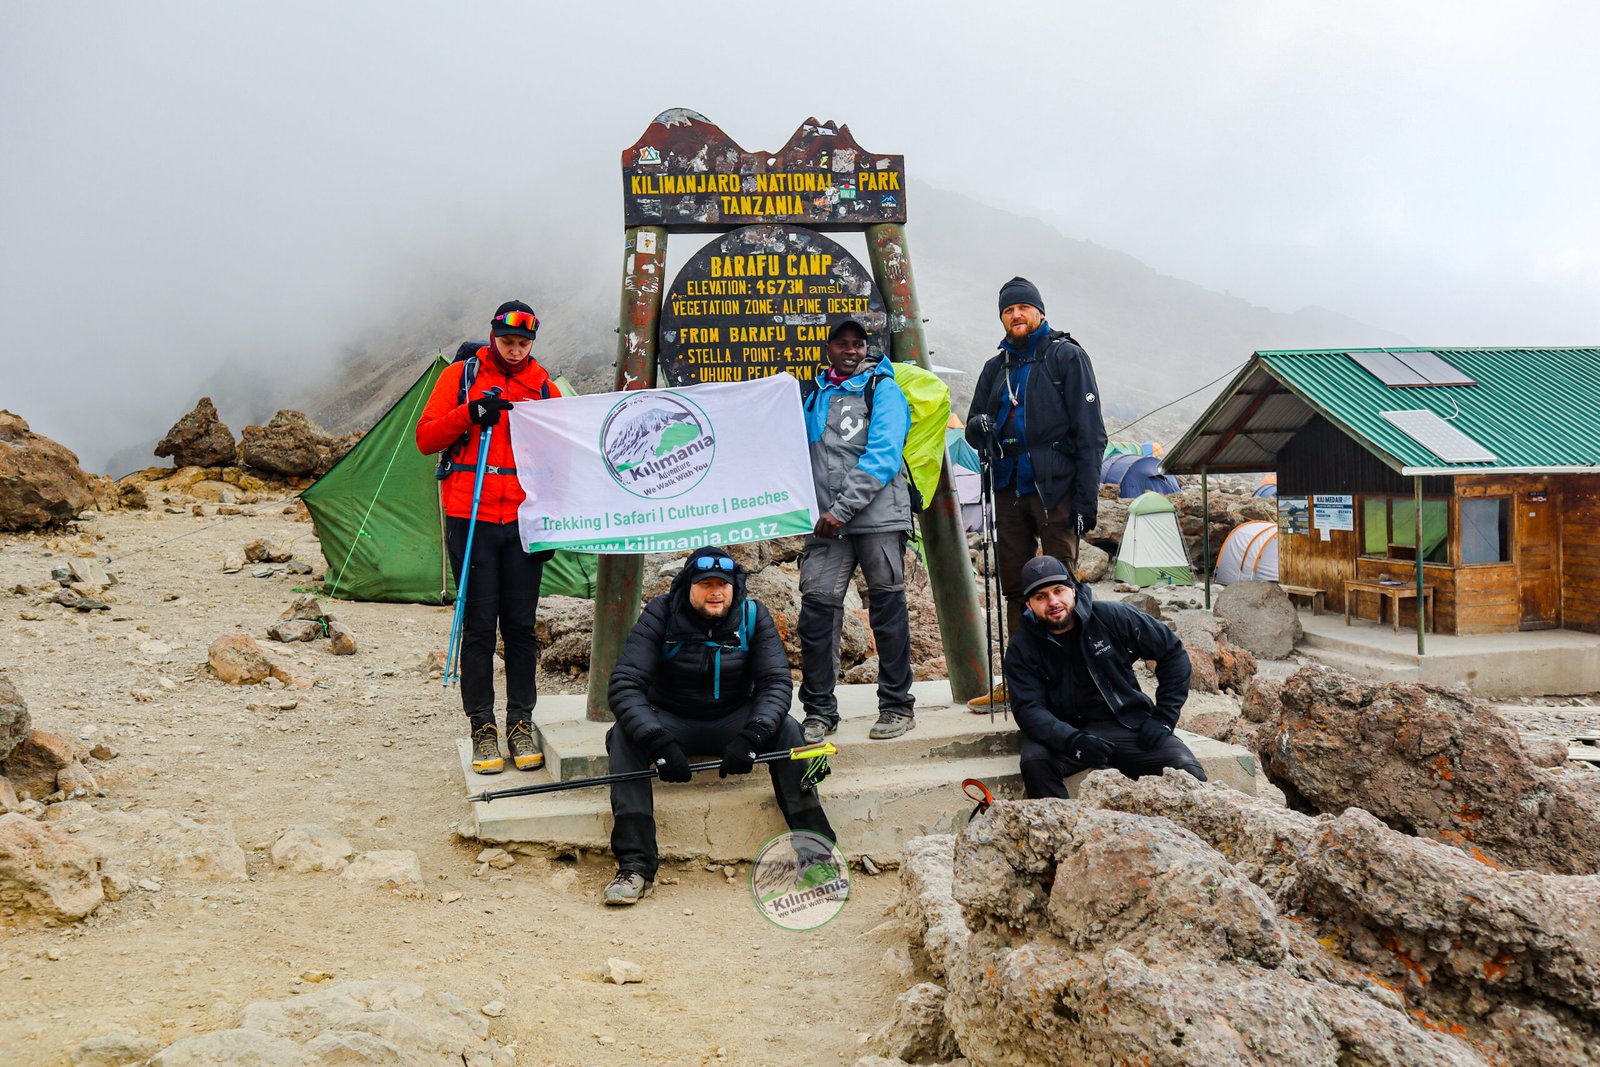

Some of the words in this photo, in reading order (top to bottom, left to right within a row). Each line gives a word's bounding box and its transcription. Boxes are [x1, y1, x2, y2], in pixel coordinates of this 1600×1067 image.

[631, 173, 741, 195] KILIMANJARO
[756, 172, 833, 192] NATIONAL
[858, 171, 900, 191] PARK
[720, 195, 804, 216] TANZANIA
[710, 255, 780, 278] BARAFU
[786, 254, 833, 276] CAMP
[687, 280, 752, 297] ELEVATION:
[755, 280, 804, 295] 4673M
[809, 284, 842, 294] amsl
[672, 300, 740, 316] VEGETATION
[745, 300, 779, 315] ZONE:
[782, 300, 822, 314] ALPINE
[827, 298, 869, 314] DESERT
[680, 327, 720, 344] FROM
[729, 326, 786, 343] BARAFU
[687, 348, 732, 364] STELLA
[699, 366, 742, 383] UHURU
[629, 435, 715, 481] Kilimania
[643, 487, 657, 496] We
[656, 479, 676, 490] Walk
[676, 469, 694, 481] With
[693, 462, 708, 473] You
[658, 460, 691, 480] Adventure
[541, 515, 602, 531] Trekking
[613, 509, 656, 526] Safari
[668, 502, 719, 520] Culture
[731, 489, 789, 511] Beaches
